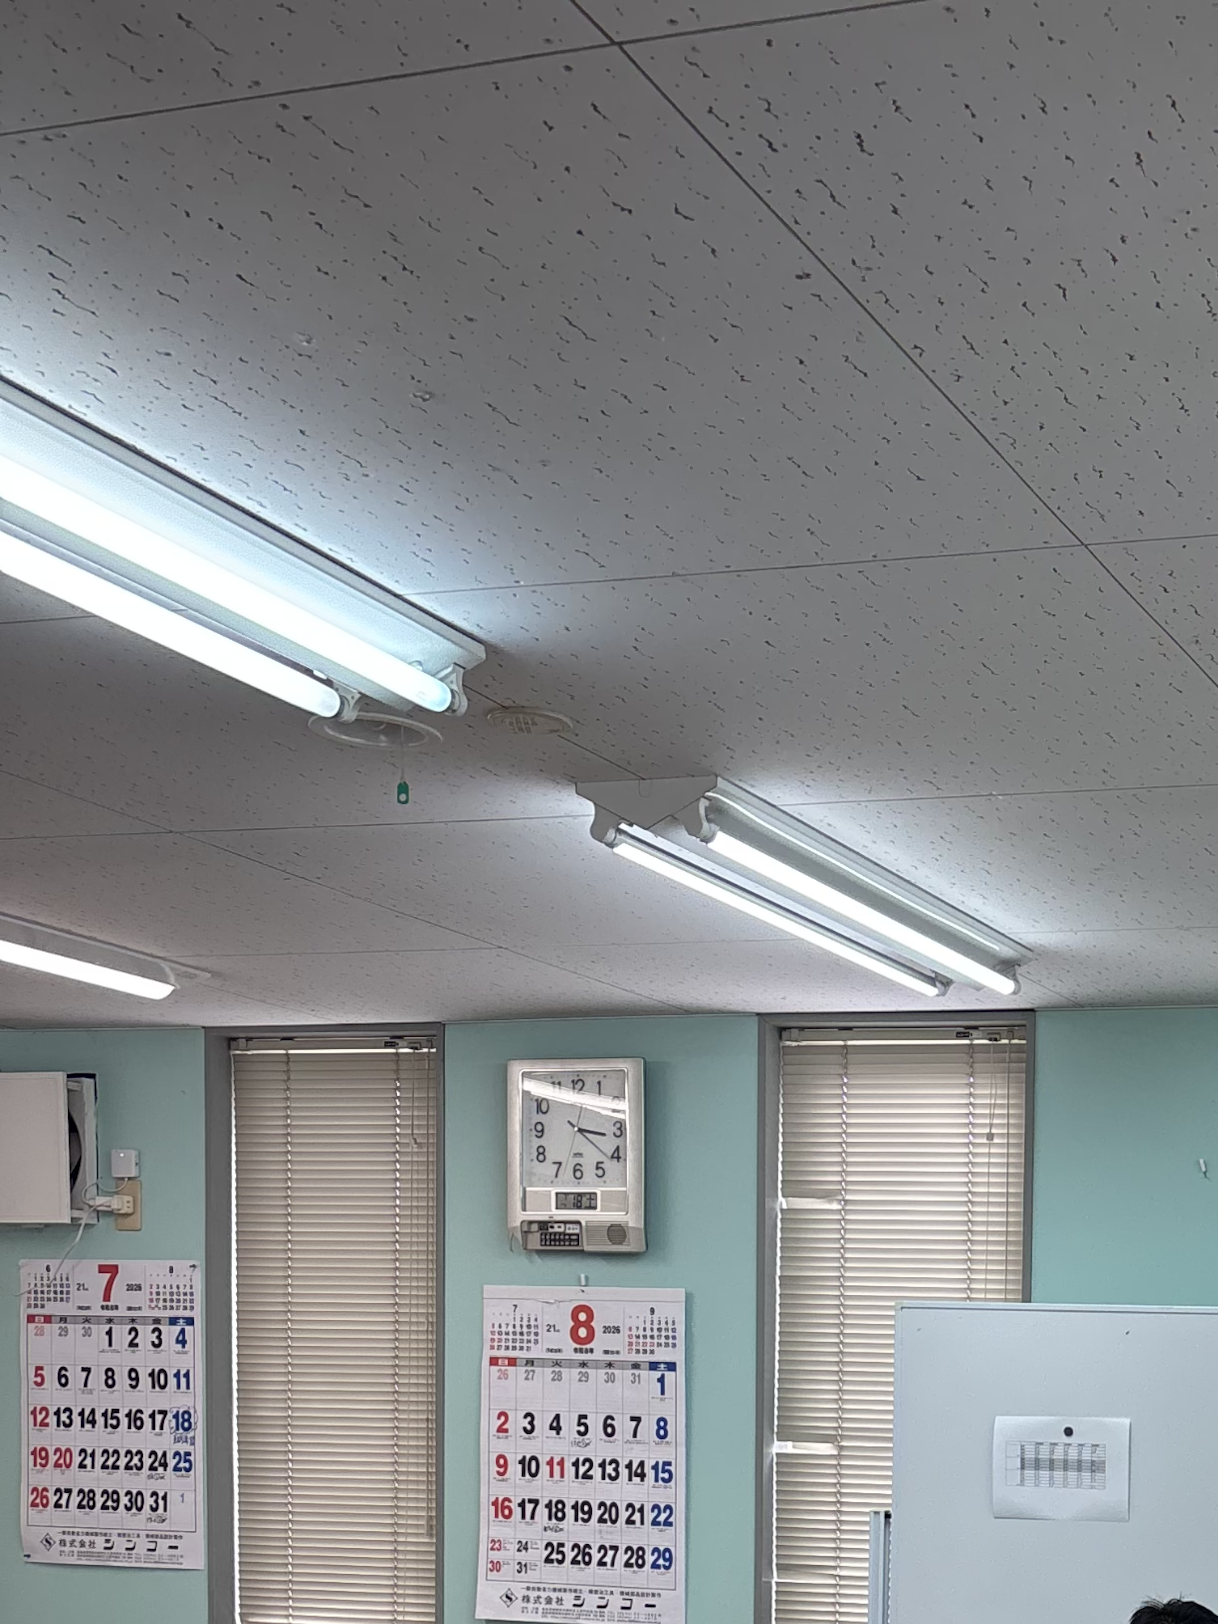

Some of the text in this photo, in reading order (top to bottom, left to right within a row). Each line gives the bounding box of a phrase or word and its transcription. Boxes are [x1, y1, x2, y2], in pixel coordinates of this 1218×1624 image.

[572, 1079, 585, 1093] 12
[597, 1081, 601, 1096] 1
[535, 1099, 549, 1114] 10
[534, 1122, 544, 1138] 9
[613, 1121, 623, 1138] 3
[536, 1145, 546, 1163] 8
[610, 1145, 621, 1163] 4
[552, 1162, 562, 1178] 7
[573, 1163, 583, 1179] 6
[595, 1162, 605, 1178] 5
[98, 1264, 118, 1302] 7
[570, 1304, 595, 1346] 8
[602, 1326, 621, 1334] 2026
[34, 1326, 187, 1349] 28 29 30 1 2 3 4
[33, 1366, 190, 1390] 5 6 7 8 9 10 11
[498, 1369, 665, 1395] 26 27 28 29 30 31 1
[31, 1406, 192, 1432] 12 13 14 15 16 17 18
[496, 1411, 668, 1440] 2 3 4 5 6 7 8
[31, 1447, 192, 1472] 19 20 21 22 23 24 25
[495, 1454, 673, 1484] 9 10 11 12 13 14 15
[31, 1487, 184, 1512] 26 27 28 29 30 31 1
[491, 1497, 673, 1527] 16 17 18 19 20 21 22
[59, 1539, 178, 1552] 株式会社 シンコー
[490, 1539, 673, 1570] 23 24 25 26 27 28 29
[489, 1560, 528, 1574] 30 31
[521, 1594, 656, 1610] 株式会社 シンコー
